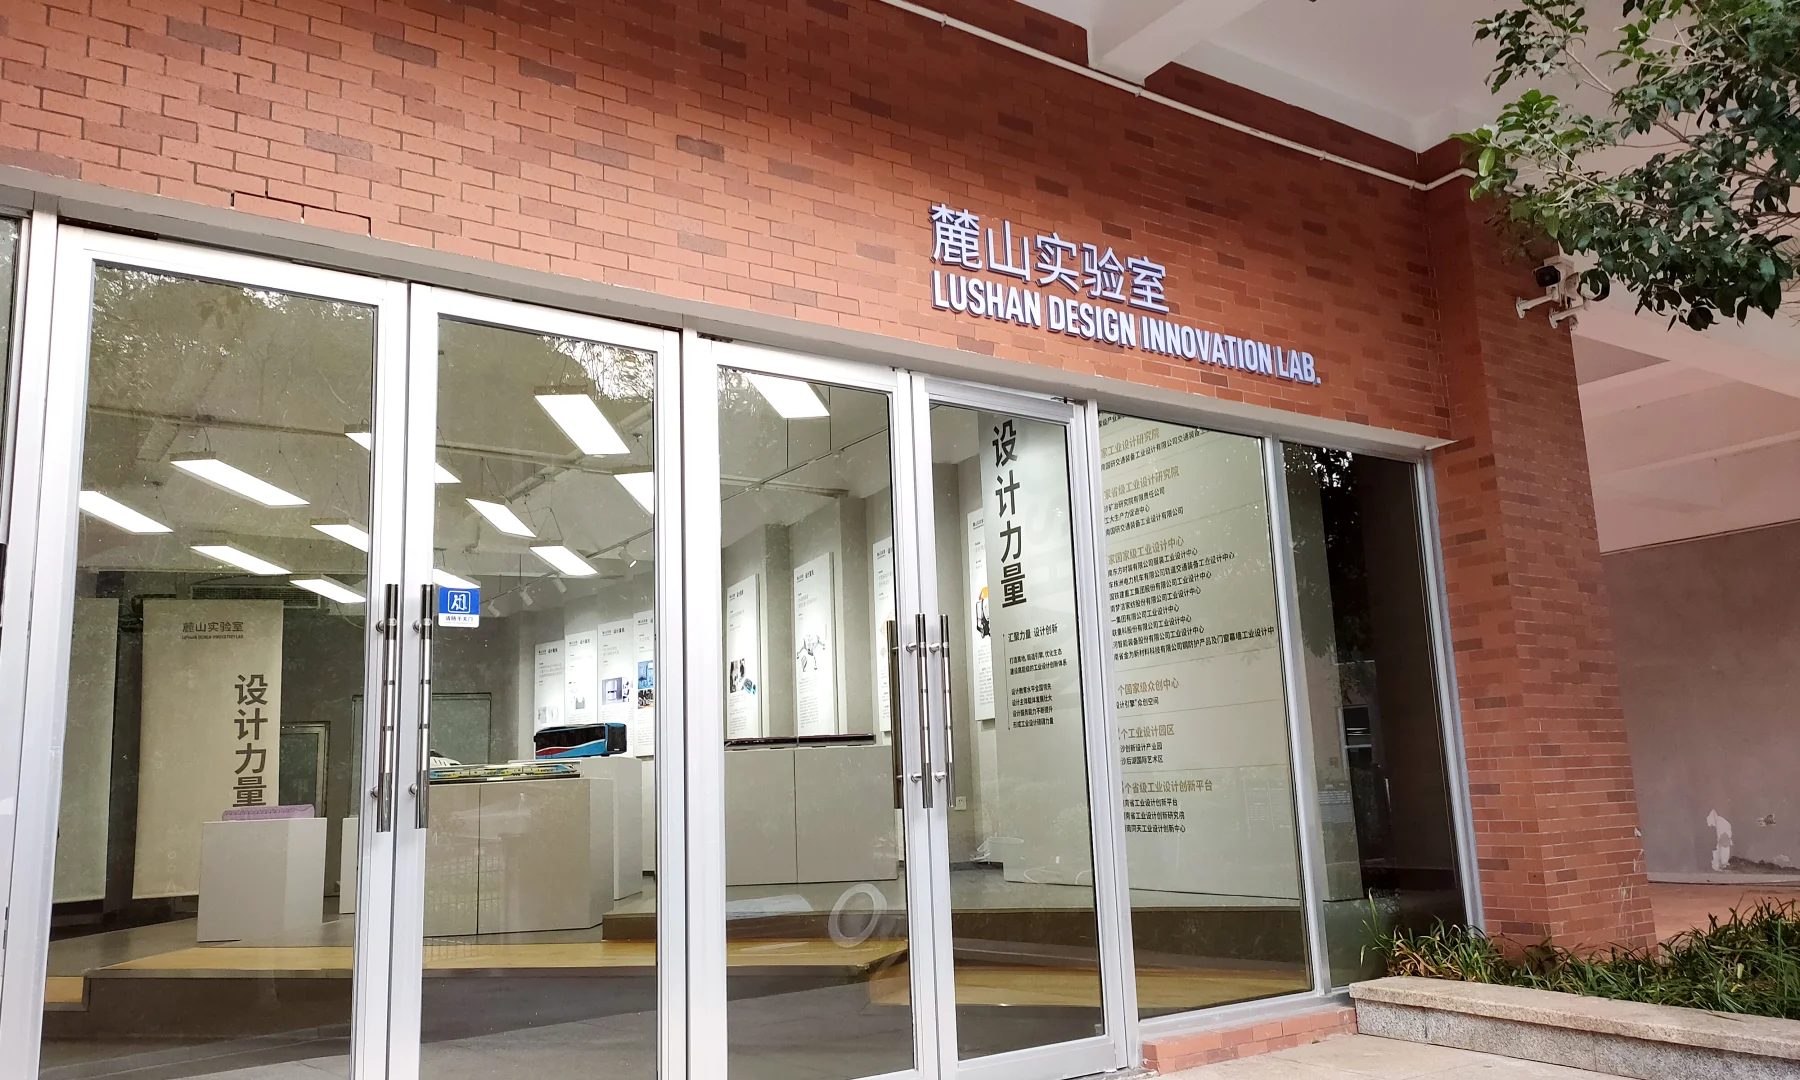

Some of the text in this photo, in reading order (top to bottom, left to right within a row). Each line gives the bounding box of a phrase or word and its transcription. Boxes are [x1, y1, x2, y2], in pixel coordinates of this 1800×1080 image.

[930, 203, 1169, 313] 麓山实验室
[931, 270, 1321, 386] LUSHAN DESIGN INNOVATION LAB.
[992, 419, 1027, 608] 设计力量
[1008, 623, 1058, 642] 汇聚力量 设计创新
[233, 674, 268, 807] 设计力量
[1118, 724, 1175, 740] 个工业设计园区
[1122, 779, 1213, 794] 个省级工业设计创新平台
[1123, 798, 1178, 807] 南省工业设计创新平台
[1124, 811, 1185, 821] 南省工业设计创新研究院
